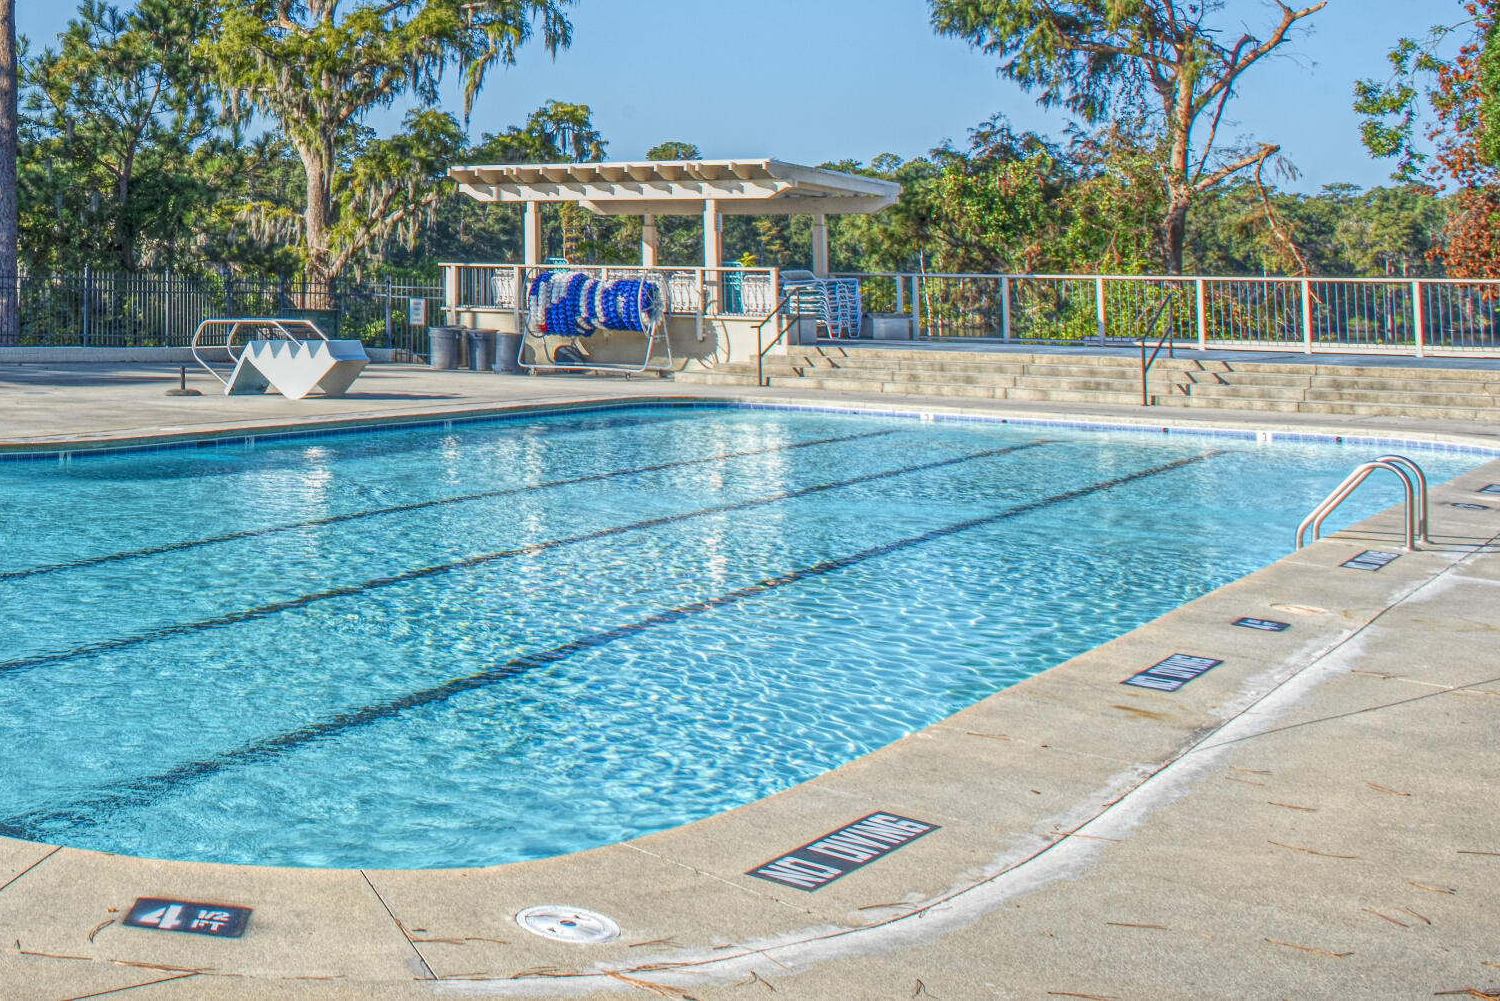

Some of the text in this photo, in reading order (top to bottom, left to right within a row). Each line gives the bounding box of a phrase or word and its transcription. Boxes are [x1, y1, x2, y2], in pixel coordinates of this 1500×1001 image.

[757, 813, 931, 889] NO DIVING
[138, 904, 183, 929] 4
[190, 919, 226, 932] FT
